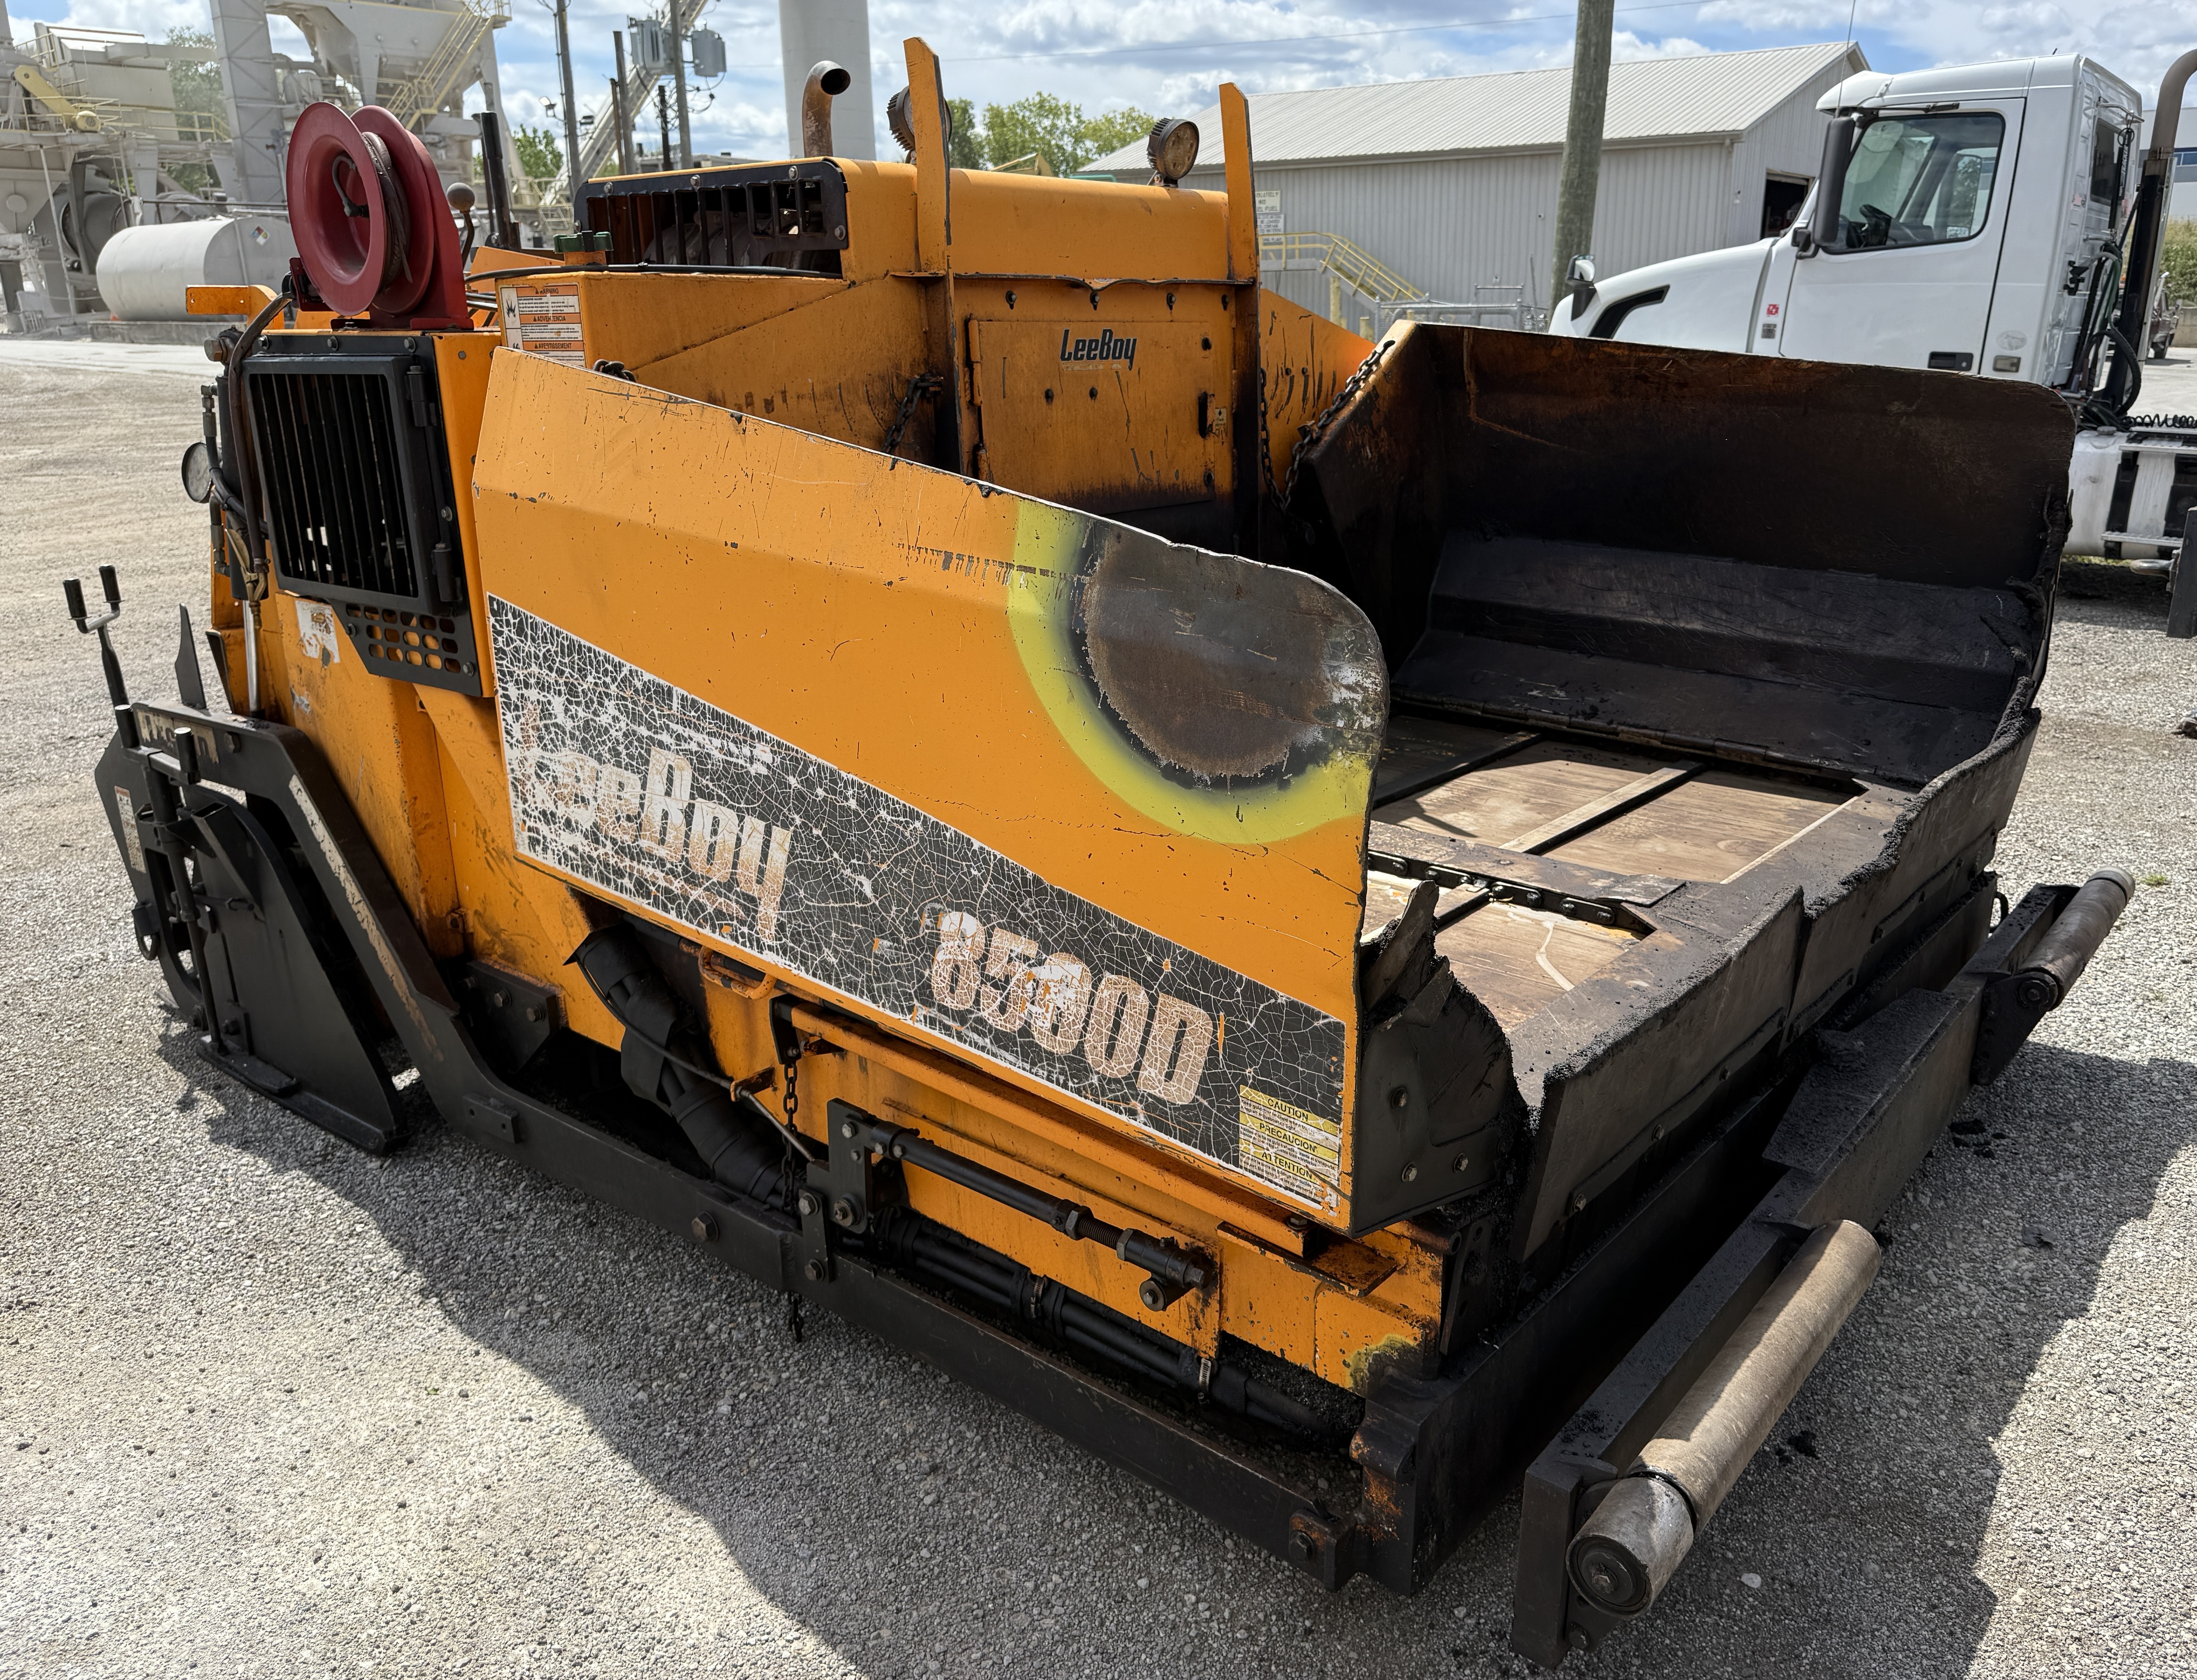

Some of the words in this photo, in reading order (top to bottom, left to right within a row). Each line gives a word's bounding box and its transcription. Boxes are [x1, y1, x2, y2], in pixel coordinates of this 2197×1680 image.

[1060, 329, 1137, 370] LeeBoy
[1267, 1098, 1308, 1121] CAUTION
[1262, 1151, 1312, 1179] ATTENTION
